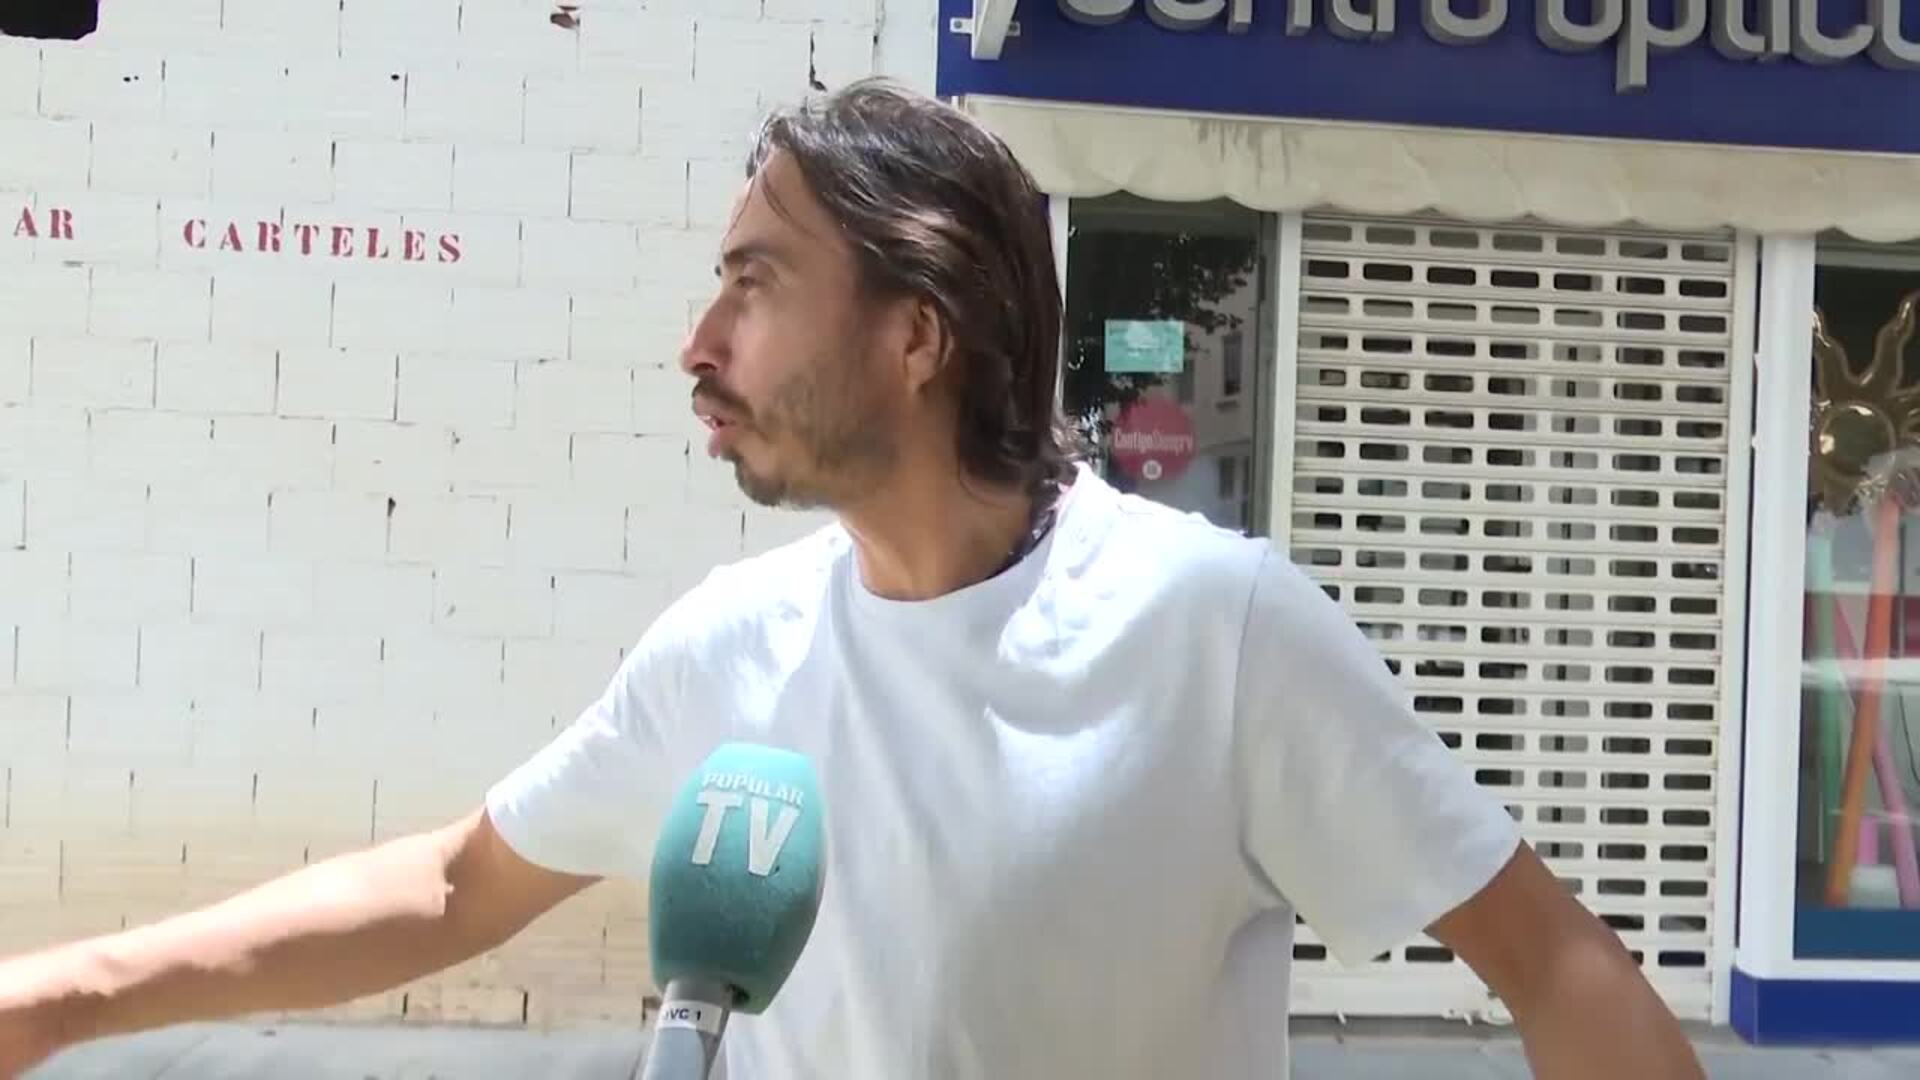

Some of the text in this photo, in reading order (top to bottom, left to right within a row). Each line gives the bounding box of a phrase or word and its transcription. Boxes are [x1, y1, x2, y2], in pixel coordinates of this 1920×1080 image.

[14, 206, 462, 264] AR CARTELES
[702, 771, 804, 806] POPULAR
[691, 790, 801, 877] TV
